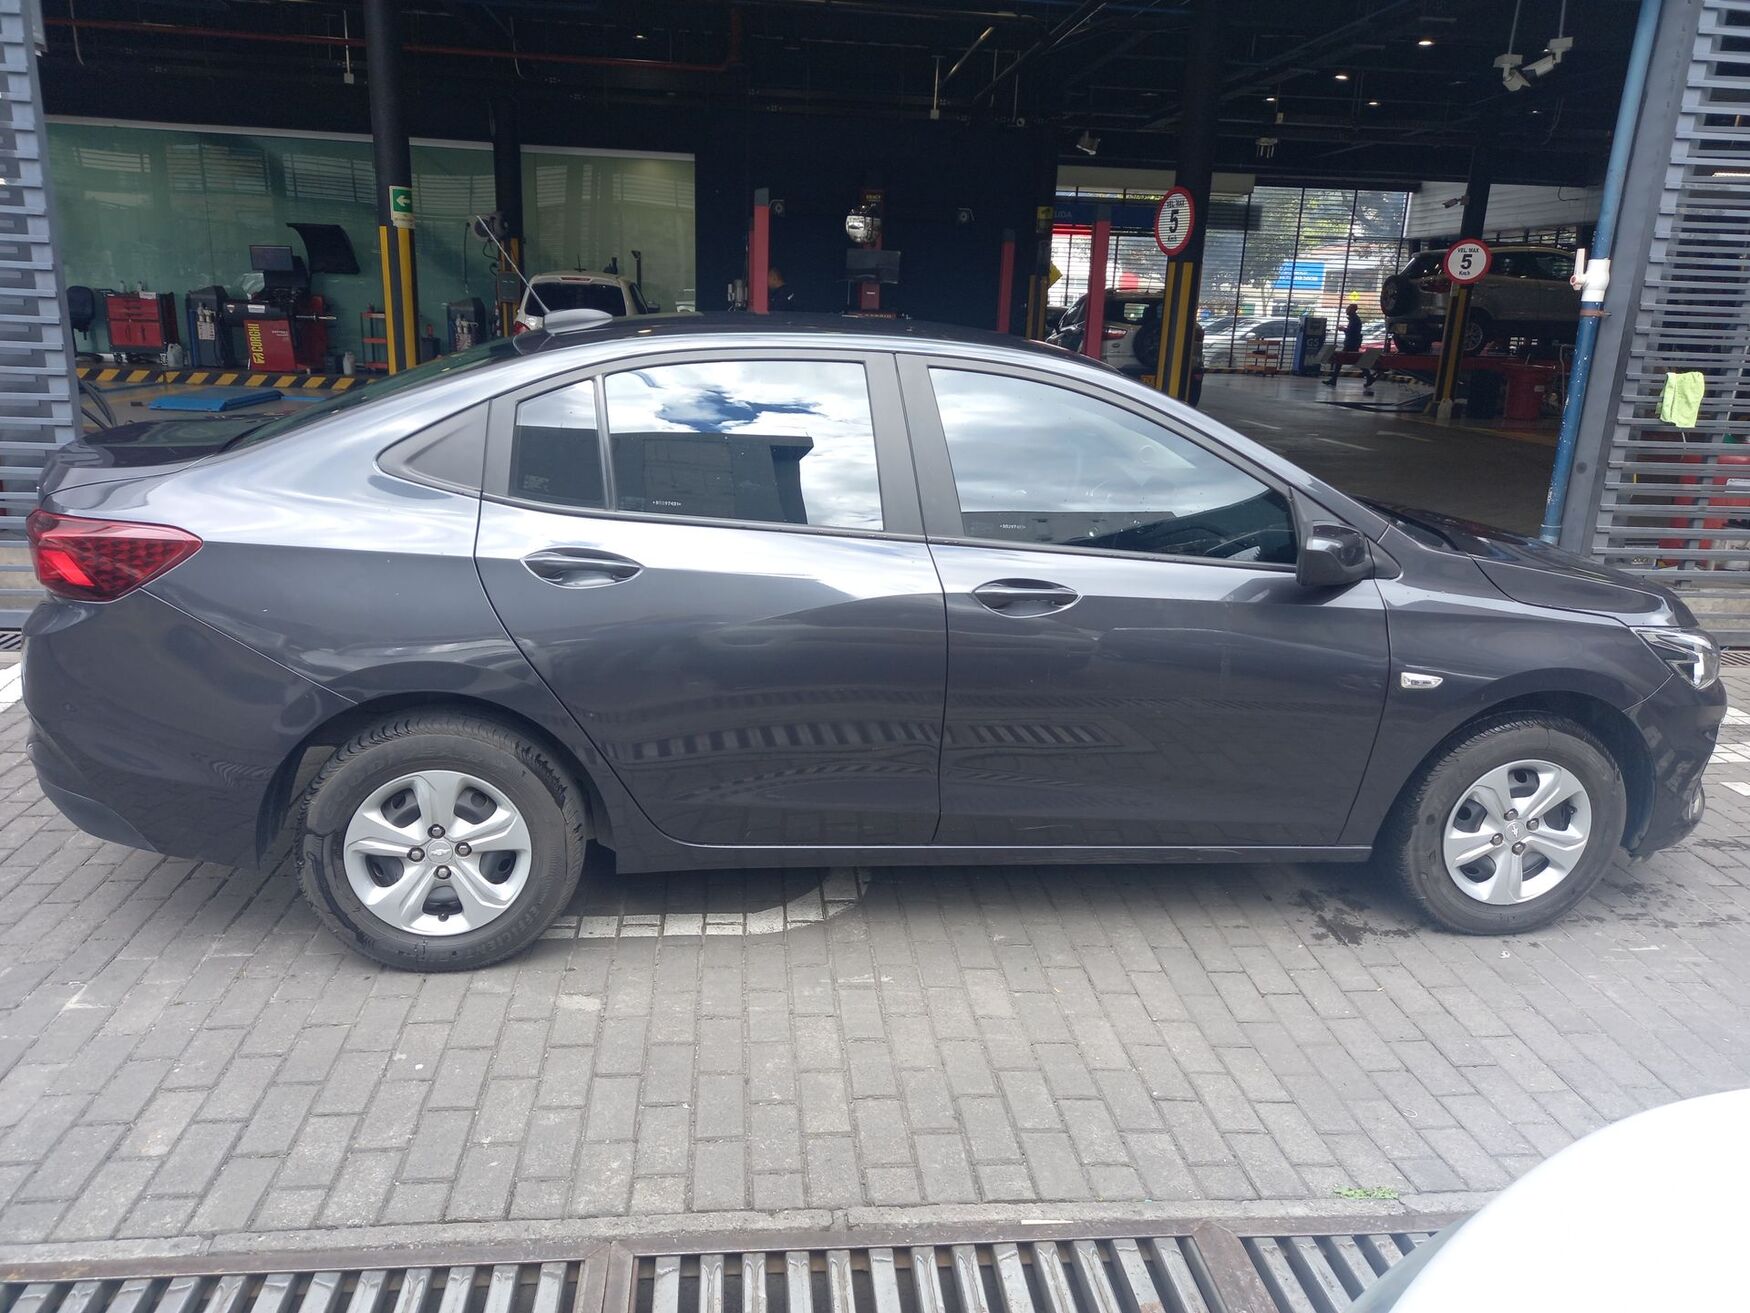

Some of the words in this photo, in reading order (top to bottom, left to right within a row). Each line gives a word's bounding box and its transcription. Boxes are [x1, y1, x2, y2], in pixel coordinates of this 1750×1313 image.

[1169, 209, 1179, 233] 5
[1460, 254, 1472, 269] 5
[247, 323, 264, 351] CORGHI
